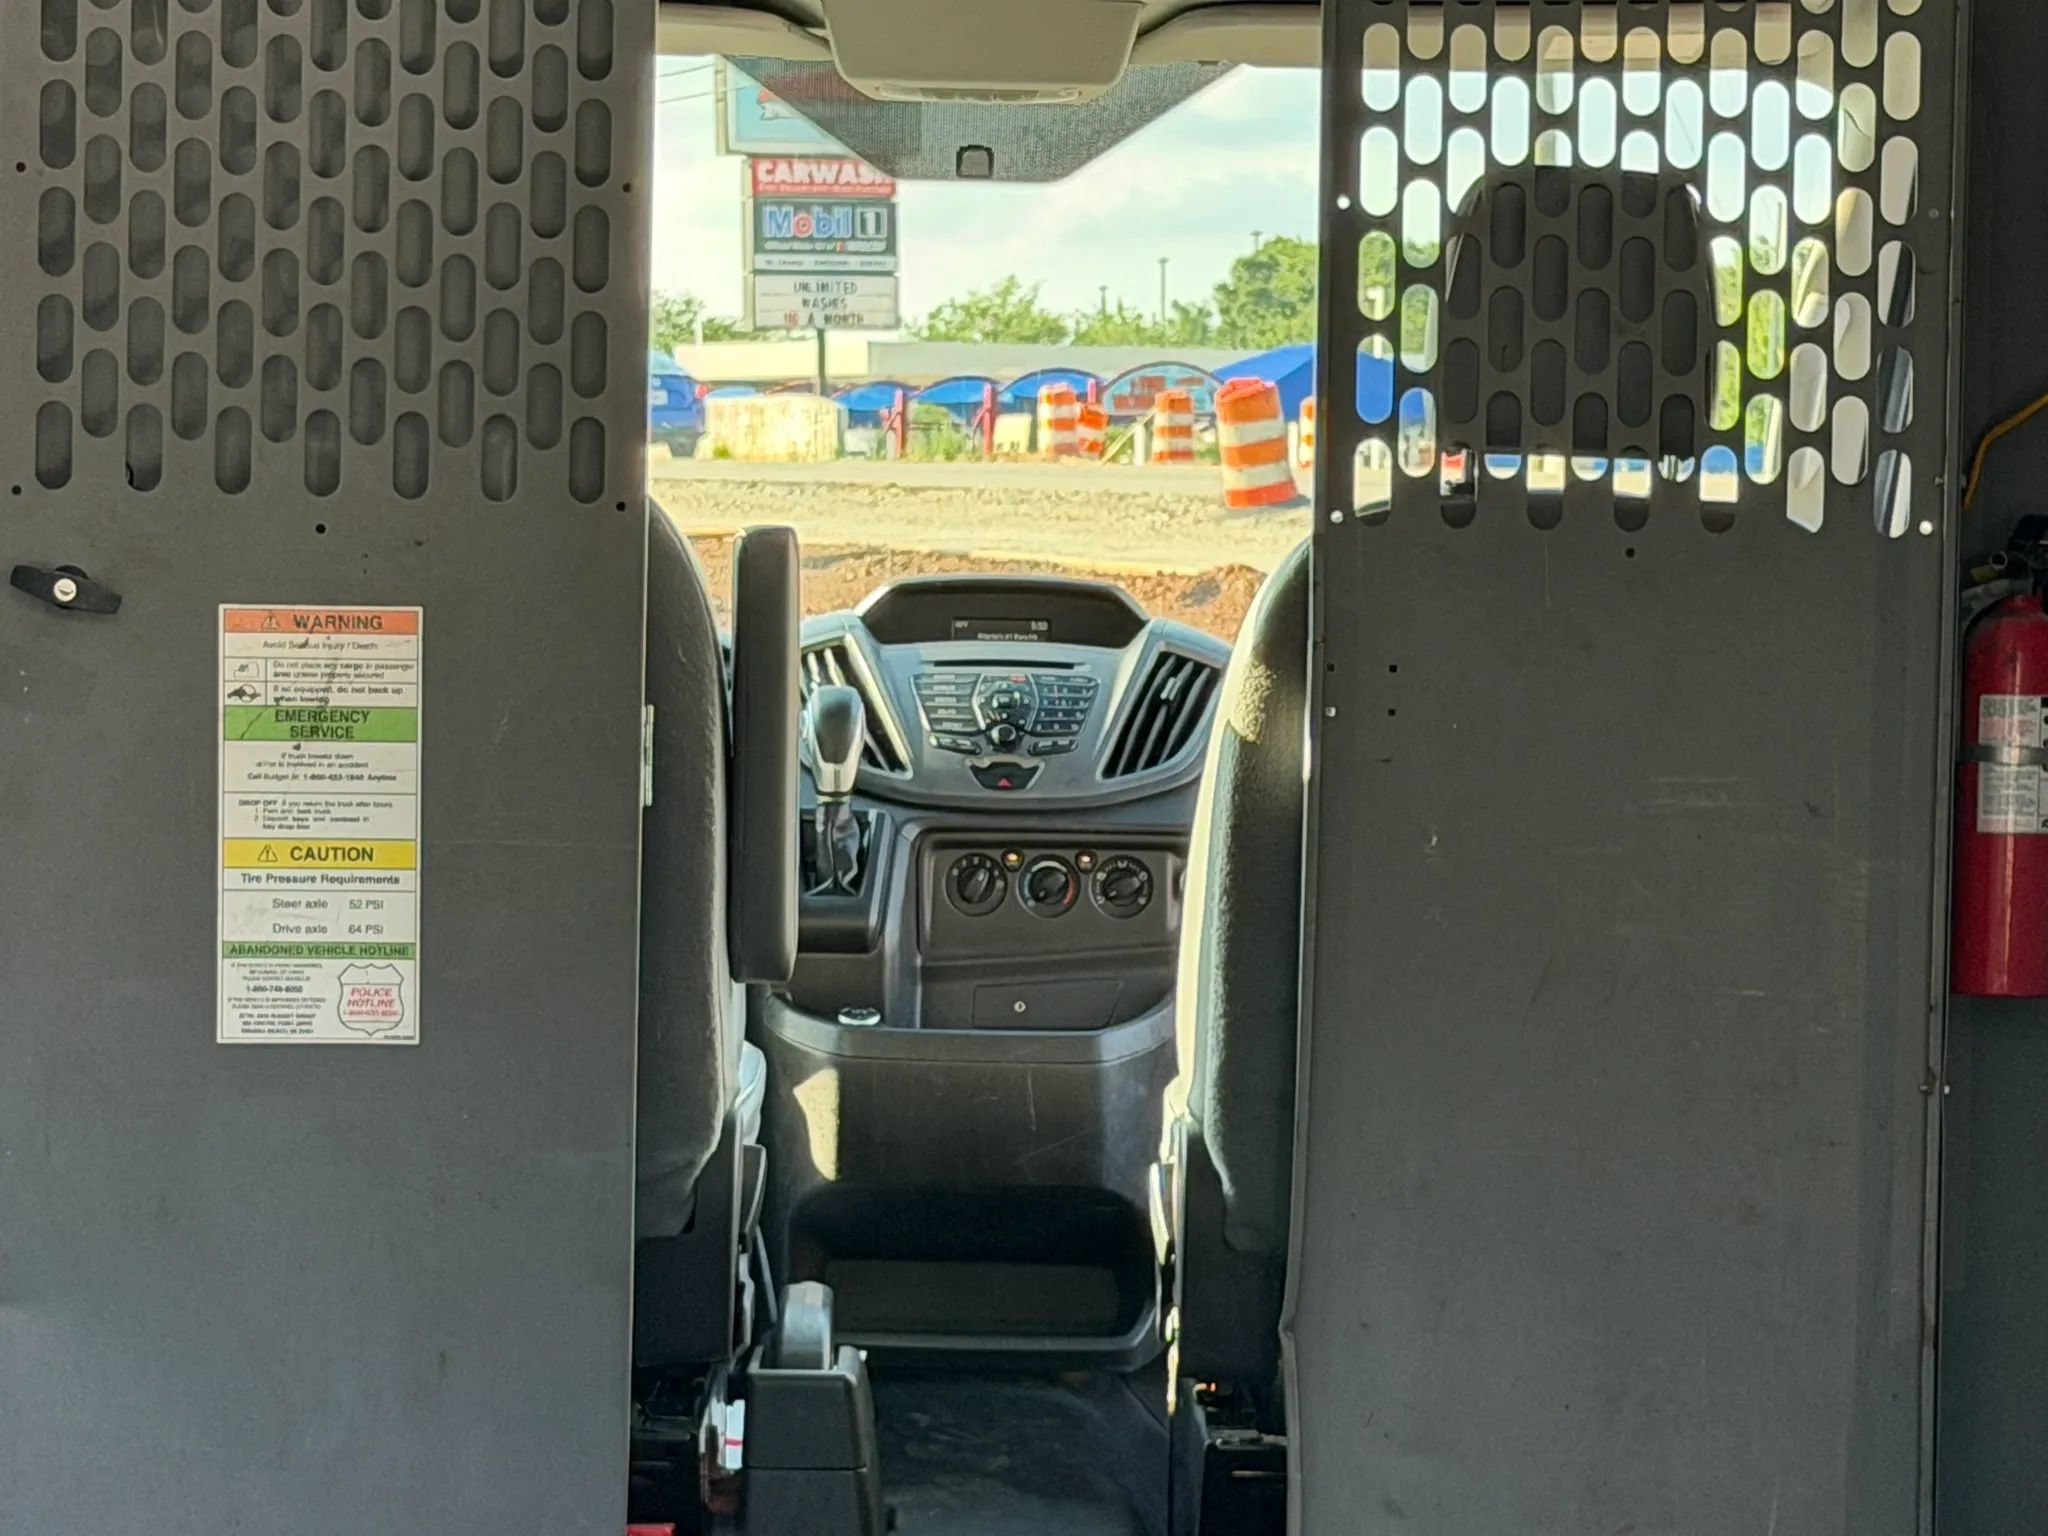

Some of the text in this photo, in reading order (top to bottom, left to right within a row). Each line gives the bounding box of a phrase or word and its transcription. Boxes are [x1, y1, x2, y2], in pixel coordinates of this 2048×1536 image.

[762, 204, 853, 239] Mobil
[793, 280, 858, 295] UNLIMITED
[801, 297, 848, 310] WASHES
[807, 312, 815, 325] A
[823, 313, 865, 326] MONTH
[293, 614, 384, 631] WARNING
[262, 641, 286, 649] Avoid
[321, 641, 345, 651] Injury
[274, 710, 370, 723] EMERGENCY
[289, 725, 355, 740] SERVICE
[290, 846, 374, 862] CAUTION
[241, 873, 400, 886] Tire Pressure Requirements
[272, 898, 384, 910] Steer axle 52 PSI
[272, 923, 384, 934] Drive axle 64 PSI
[229, 944, 409, 957] ABANDONED VEHICLE HOTLINE
[350, 987, 392, 997] POLICE
[347, 998, 396, 1008] HOTLINE
